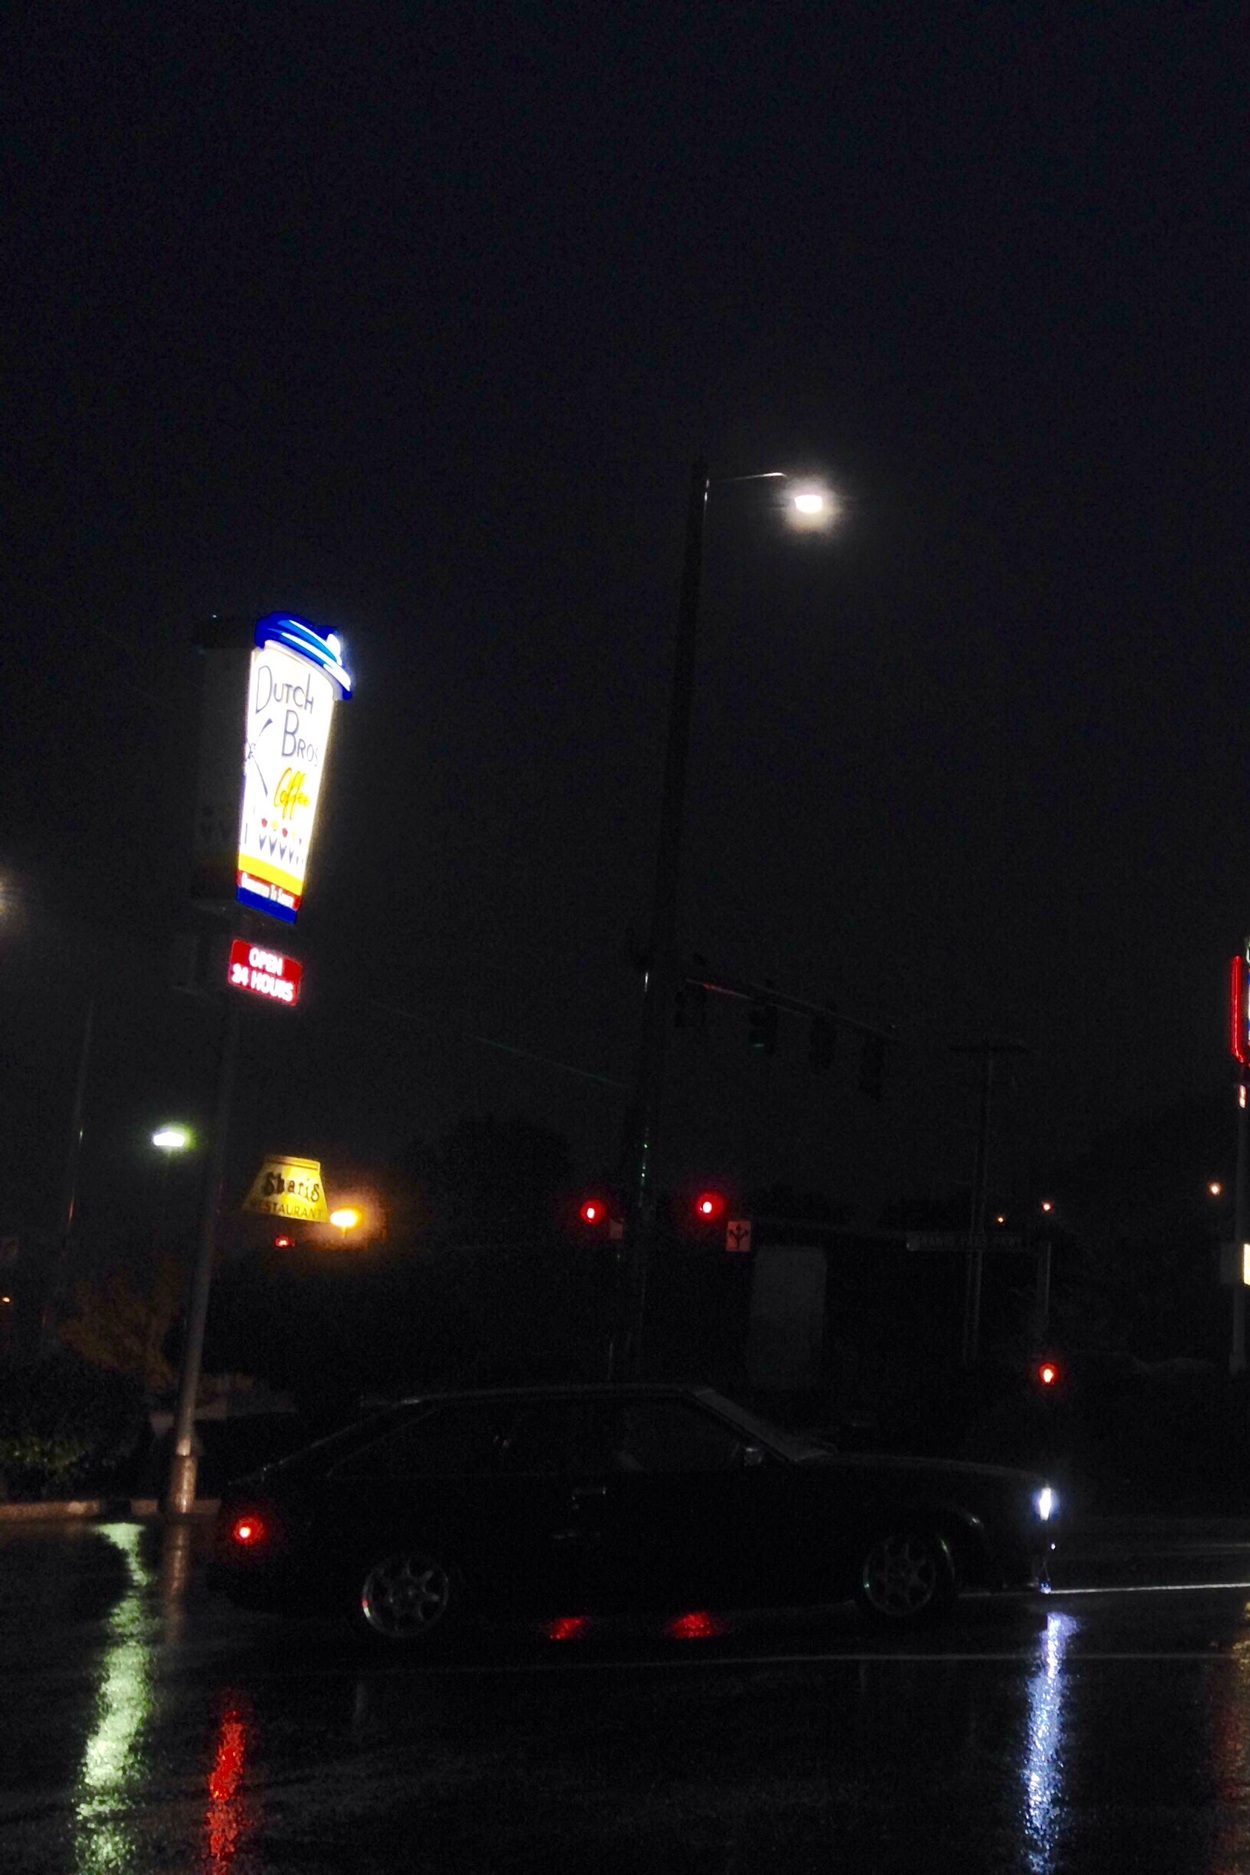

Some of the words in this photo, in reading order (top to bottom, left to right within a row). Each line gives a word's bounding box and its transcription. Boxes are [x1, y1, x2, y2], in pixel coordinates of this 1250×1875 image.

[249, 947, 283, 976] OPEN
[231, 962, 249, 987] 24
[250, 969, 295, 1002] HOURS
